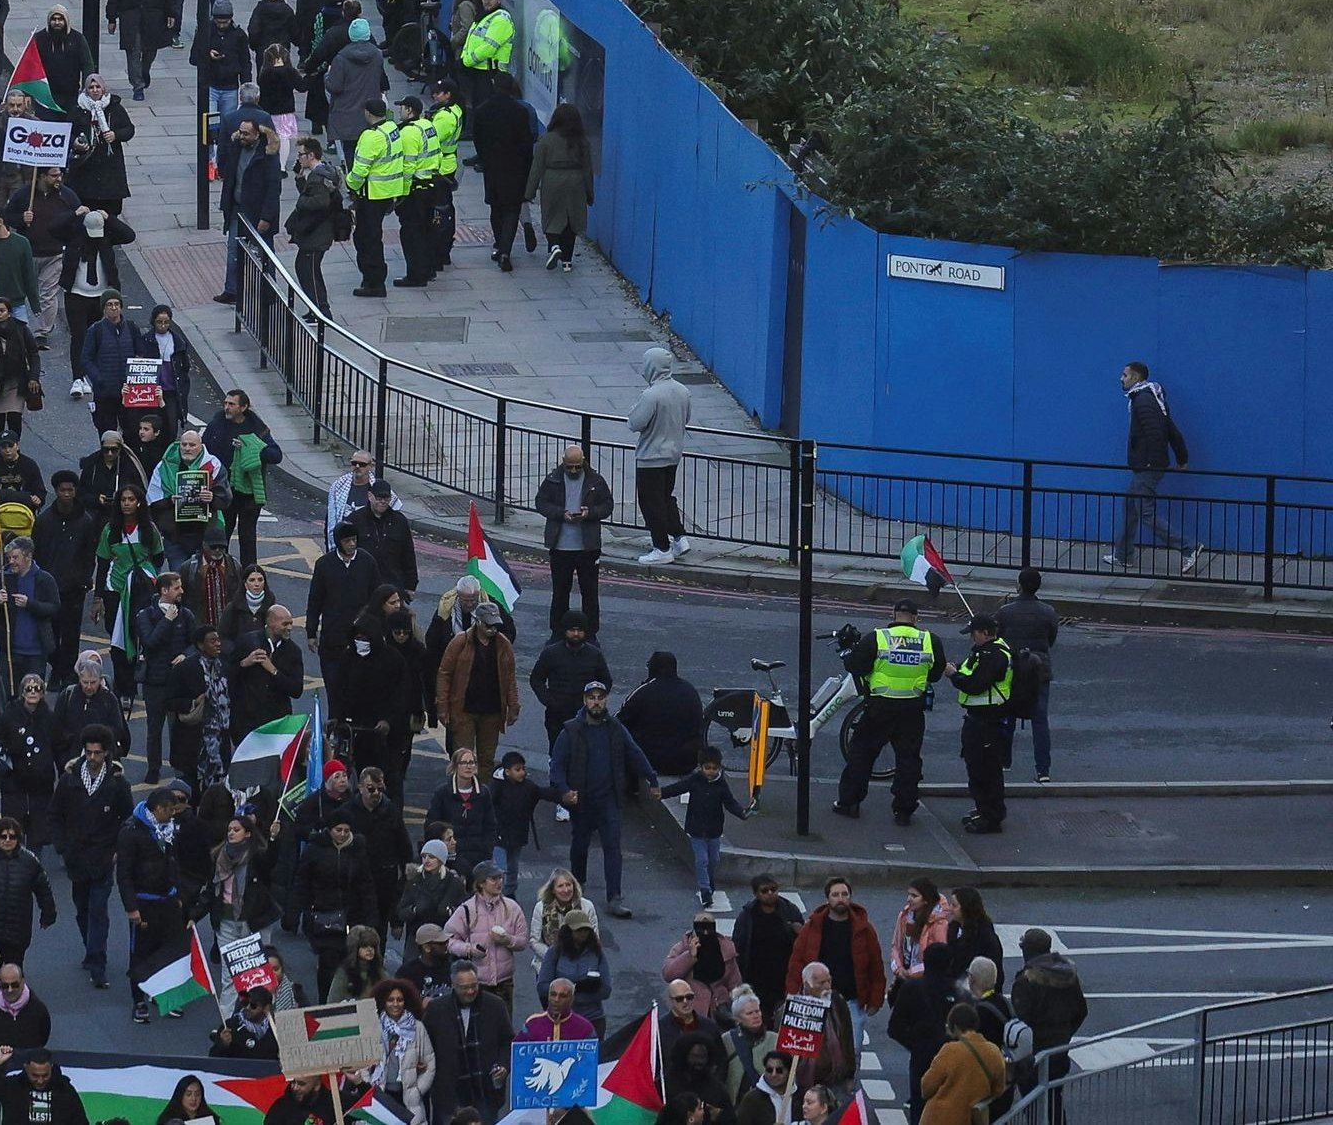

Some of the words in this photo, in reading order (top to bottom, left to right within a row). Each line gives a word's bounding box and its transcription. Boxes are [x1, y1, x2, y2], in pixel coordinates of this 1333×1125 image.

[7, 147, 22, 156] Stop
[23, 149, 33, 157] the
[895, 261, 942, 277] PONTON
[948, 267, 981, 282] ROAD
[129, 364, 158, 373] FREEDOM
[126, 375, 158, 384] PALESTINE
[889, 653, 921, 664] POLICE
[226, 942, 261, 963] FREEDOM
[229, 955, 268, 976] PALESTINE
[788, 1000, 825, 1018] FREEDOM
[783, 1013, 824, 1033] PALESTINE
[518, 1043, 575, 1057] CEASEFIRE
[576, 1041, 597, 1053] NOW
[516, 1094, 559, 1107] PEACE
